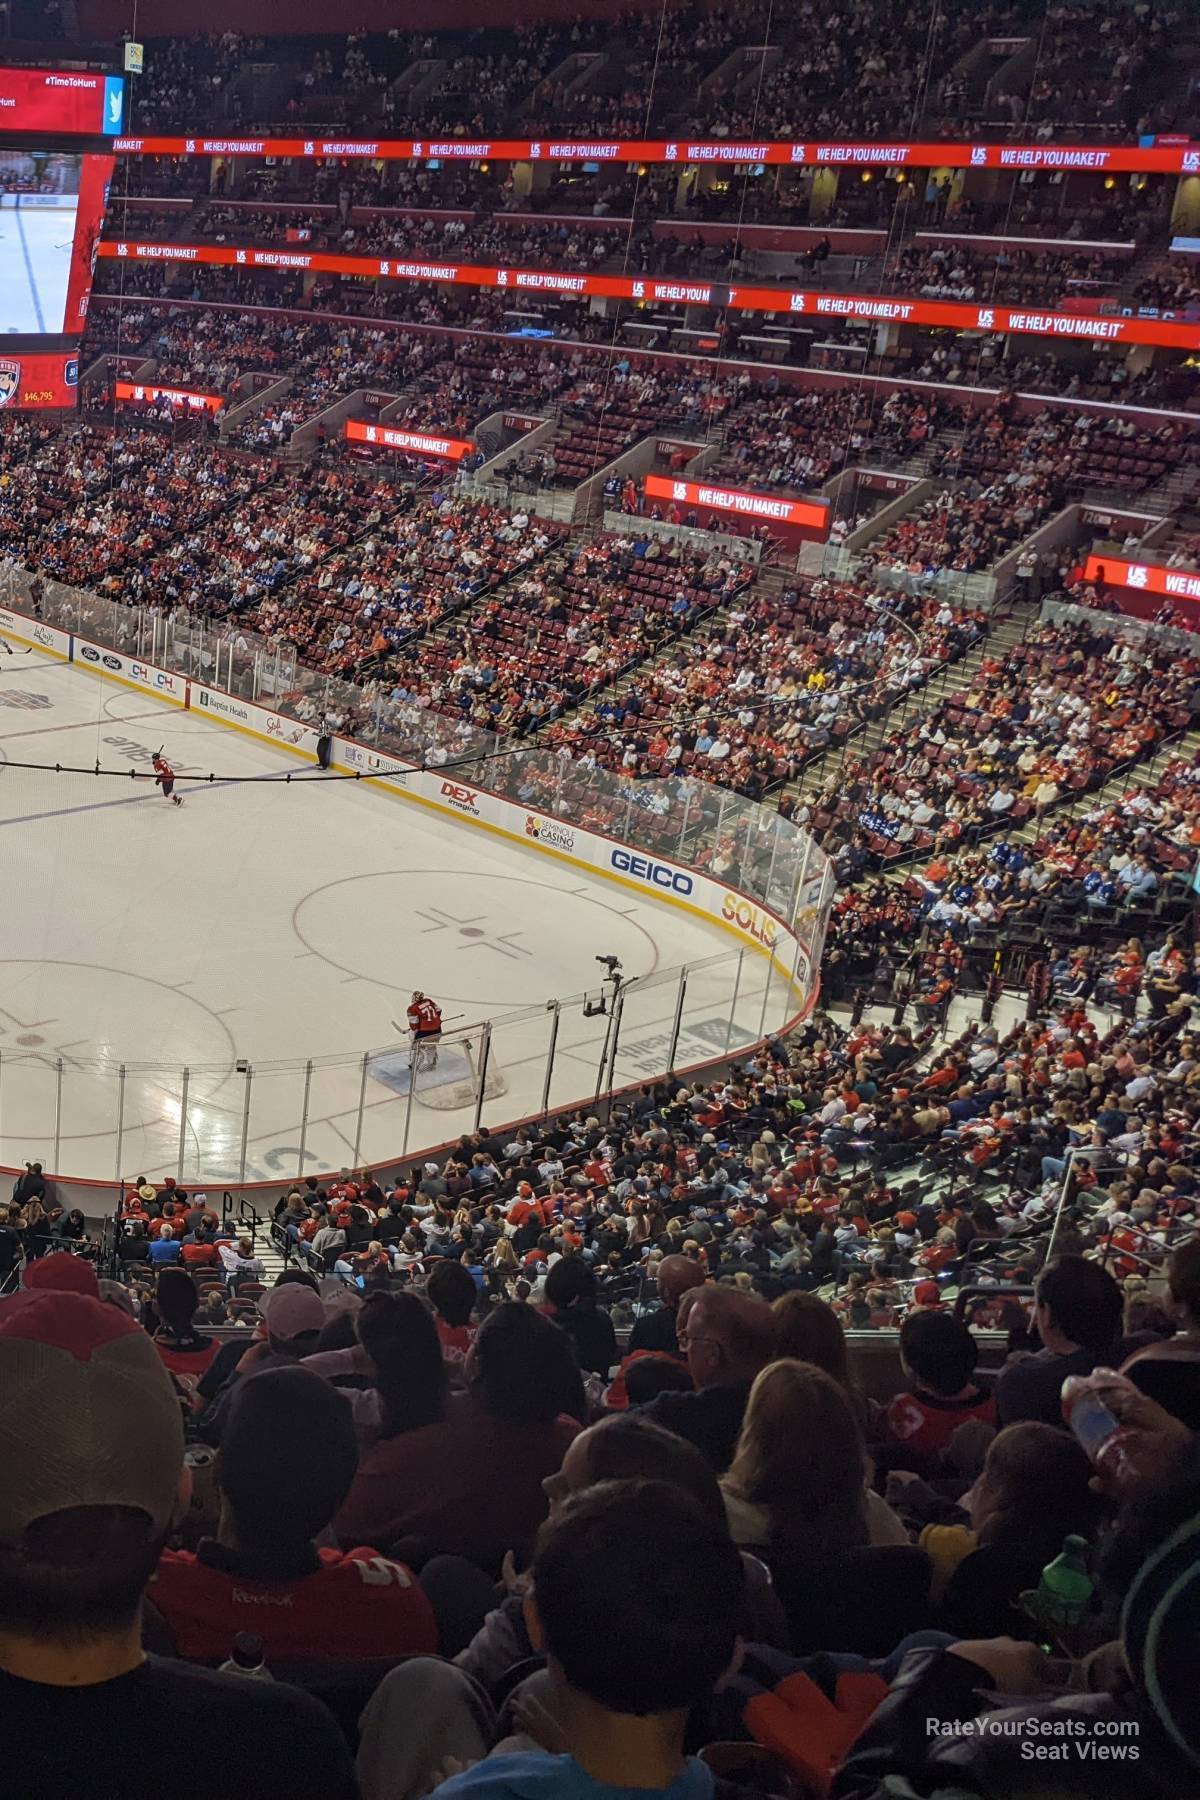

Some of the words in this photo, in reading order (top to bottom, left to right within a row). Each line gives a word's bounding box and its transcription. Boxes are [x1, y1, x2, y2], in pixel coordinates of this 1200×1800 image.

[46, 77, 96, 88] #TimeToHunt
[688, 147, 700, 158] WE
[700, 147, 718, 158] HELP
[720, 147, 736, 159] YOU
[736, 148, 758, 159] MAKE
[817, 148, 829, 160] WE
[830, 148, 851, 160] HELP
[853, 148, 870, 160] YOU
[871, 149, 896, 161] MAKE
[1001, 150, 1017, 163] WE
[1018, 151, 1041, 164] HELP
[1044, 151, 1062, 165] YOU
[1062, 152, 1095, 165] MAKE
[1009, 315, 1024, 329] WE
[1025, 316, 1051, 332] HELP
[1054, 318, 1072, 333] YOU
[1072, 320, 1108, 336] MAKE
[25, 392, 53, 402] $46,795
[83, 648, 99, 660] Ford
[104, 657, 120, 668] Ford
[132, 664, 148, 678] CH
[157, 674, 172, 688] CH
[210, 698, 229, 714] Baptist
[229, 702, 248, 720] Health
[440, 782, 478, 806] DEX
[448, 798, 480, 816] imaging
[542, 821, 576, 838] SEMINOLE
[540, 829, 574, 848] CASINO
[611, 850, 693, 895] GEICO
[722, 892, 776, 948] SOLIS
